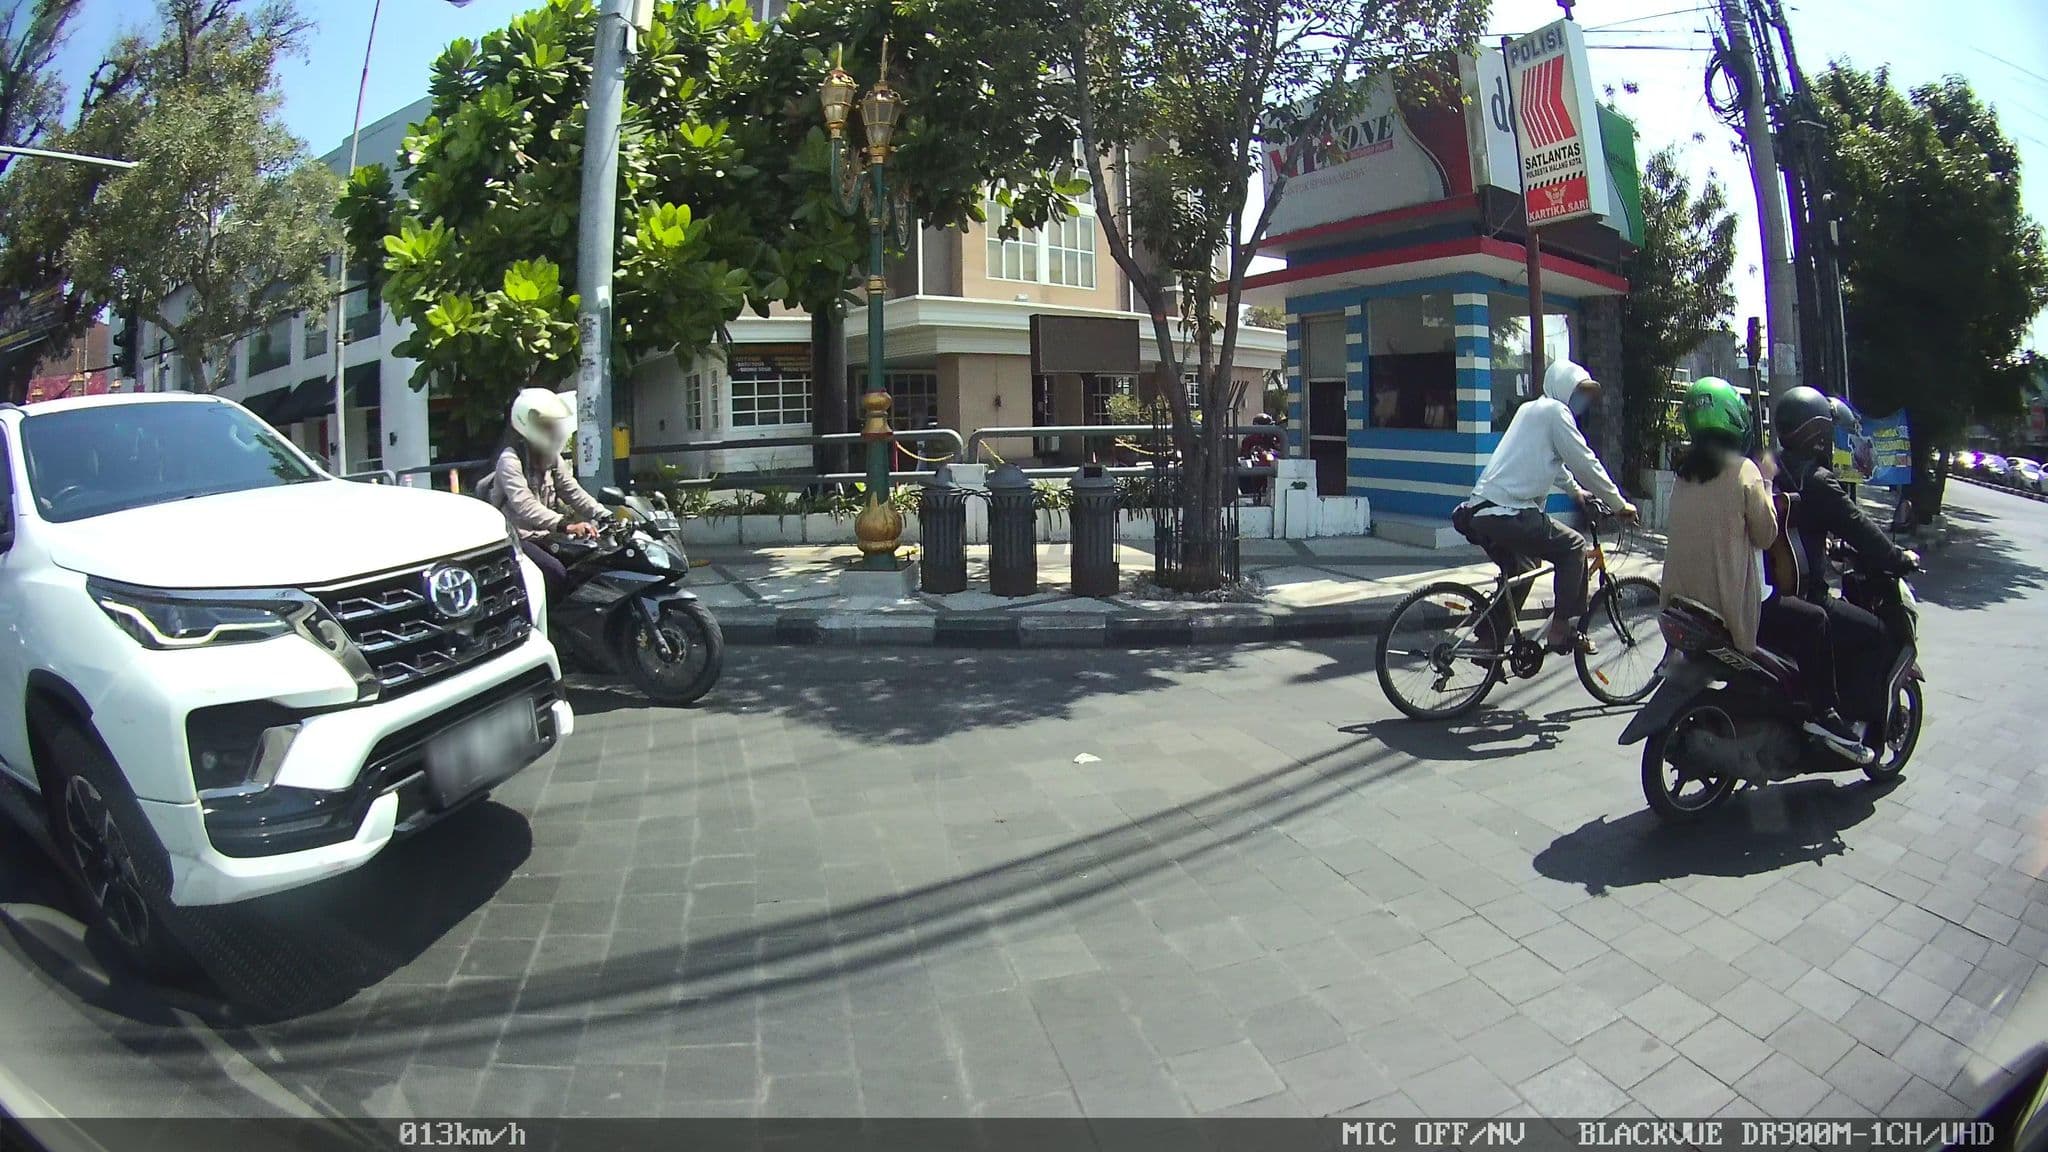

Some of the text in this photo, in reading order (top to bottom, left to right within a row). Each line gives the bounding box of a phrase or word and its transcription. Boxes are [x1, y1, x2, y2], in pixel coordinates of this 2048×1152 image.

[1510, 27, 1565, 68] POLISI
[1525, 142, 1581, 170] SATLANTAS
[1528, 199, 1589, 222] KARTIKA SARI
